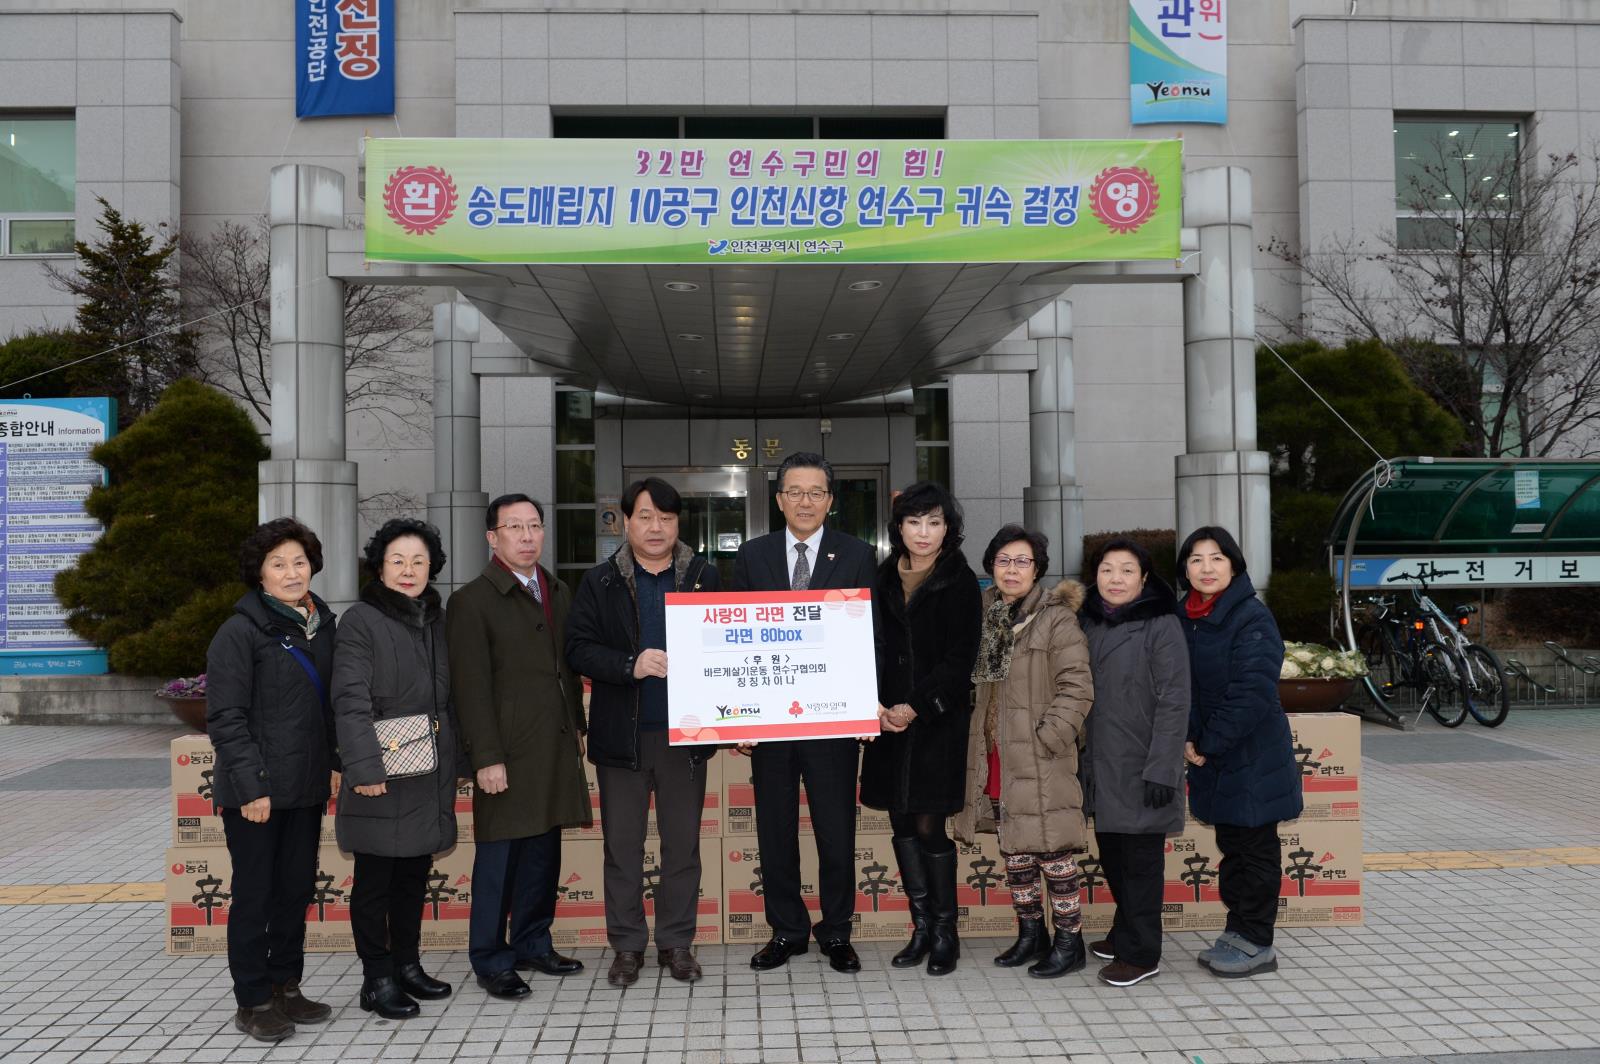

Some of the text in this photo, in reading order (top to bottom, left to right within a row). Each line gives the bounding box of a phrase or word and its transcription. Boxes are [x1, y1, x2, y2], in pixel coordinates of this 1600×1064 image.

[1146, 81, 1211, 101] Yeonsu
[636, 150, 704, 177] 32만
[903, 149, 944, 178] 힘!
[402, 180, 440, 216] 환
[467, 184, 1080, 227] 송도매립지 10공구 인천신항 연수구 귀속 결정
[1106, 181, 1140, 218] 영
[730, 240, 844, 254] 인천광역시 연수구
[58, 427, 101, 435] Information
[703, 604, 822, 624] 사랑의 라면 전달
[725, 627, 803, 644] 라면 80box
[703, 663, 827, 677] 바르게살기운동 연수구협의회
[716, 704, 761, 719] Yeonsu
[190, 755, 213, 765] 농심
[1320, 765, 1345, 776] 라면
[1173, 842, 1196, 852] 농심
[185, 863, 208, 874] 농심
[1180, 852, 1219, 904] 辛
[1284, 847, 1347, 898] 辛 라면
[858, 861, 898, 913] 辛
[966, 855, 1006, 906] 辛
[191, 874, 233, 926] 辛
[567, 890, 595, 902] 라면
